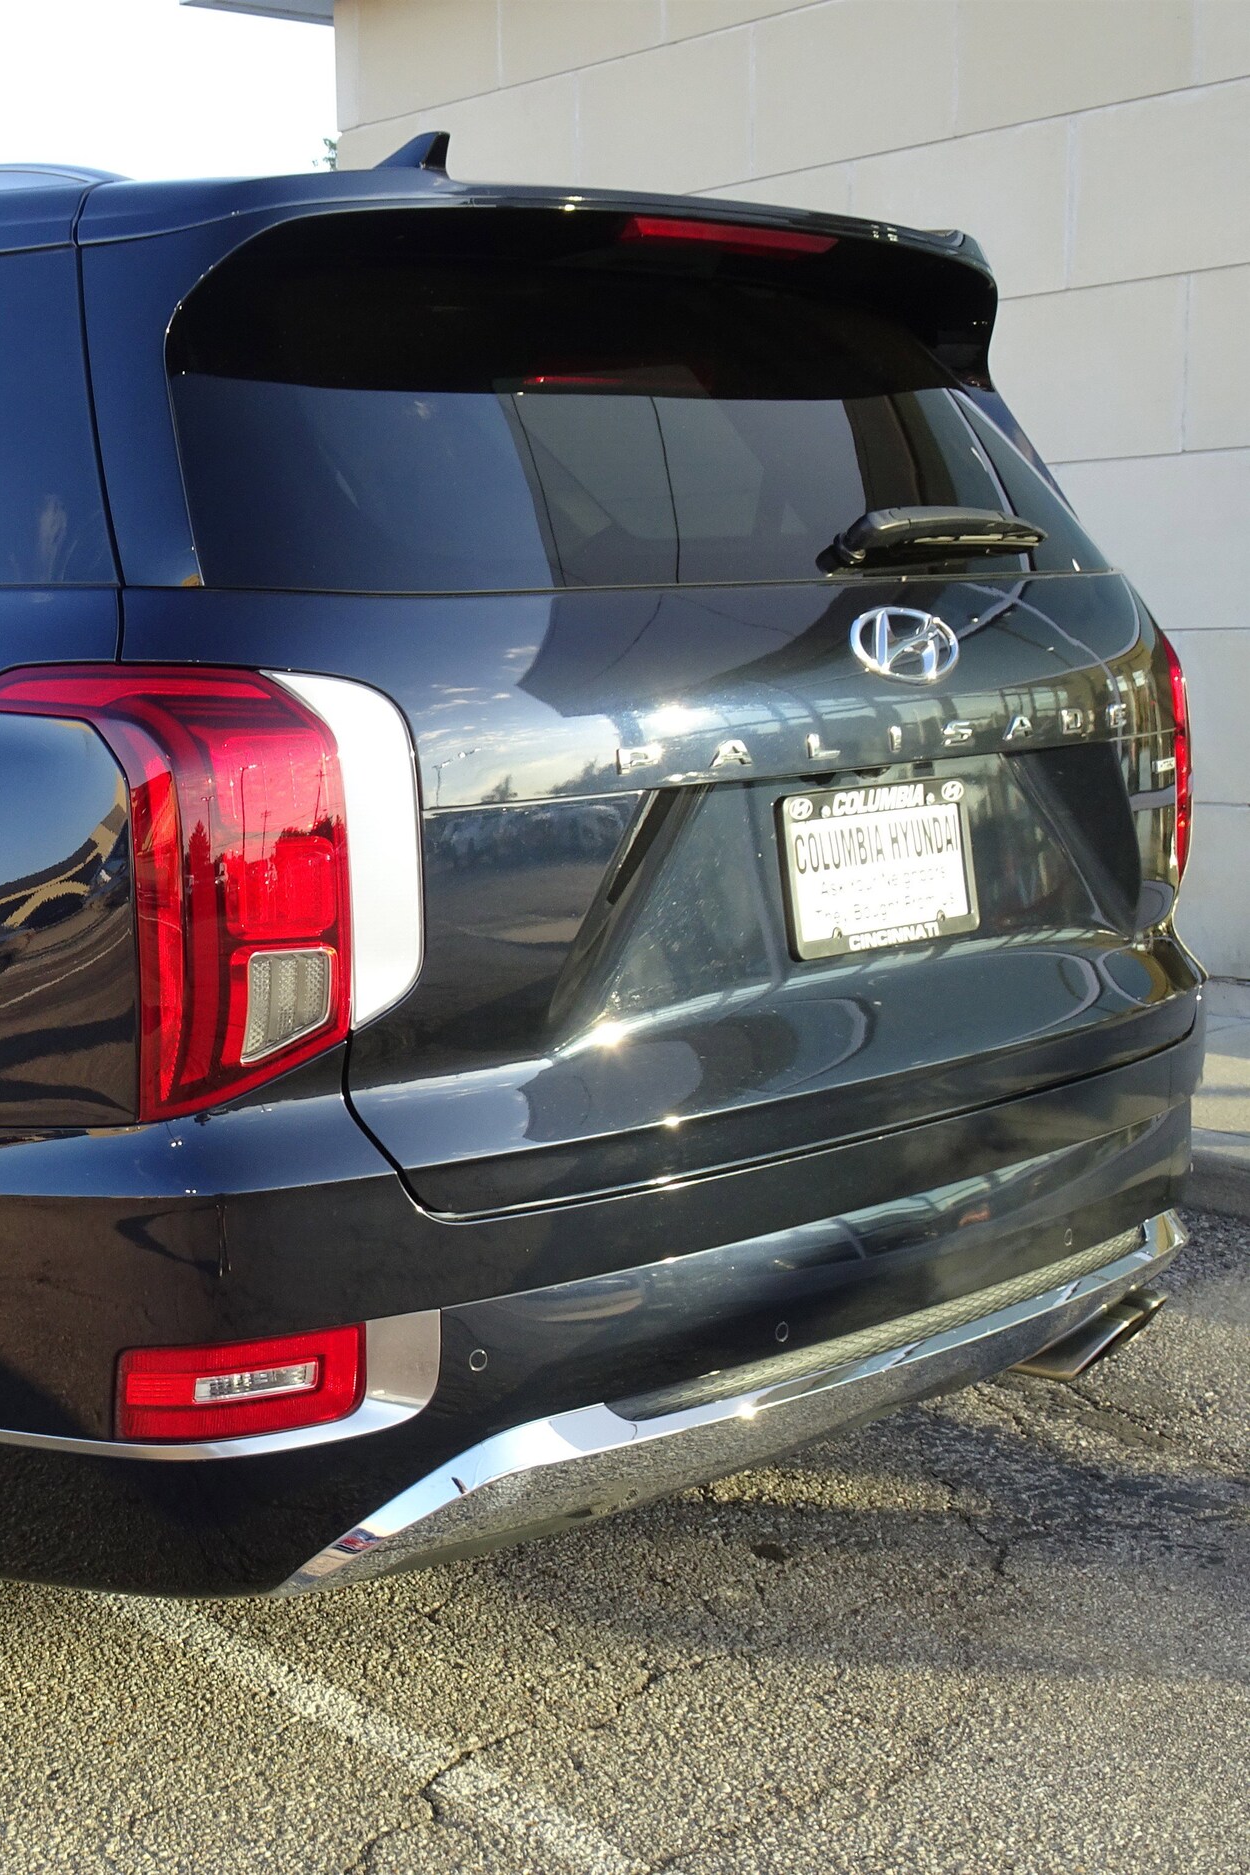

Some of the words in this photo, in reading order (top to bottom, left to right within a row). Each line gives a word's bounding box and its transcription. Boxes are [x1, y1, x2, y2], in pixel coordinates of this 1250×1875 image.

[616, 703, 1128, 776] PALISADE
[832, 784, 924, 816] COLUMBIA
[794, 824, 885, 874] COLUMBIA
[888, 814, 959, 860] HYUNDAI
[881, 866, 946, 889] Negos
[853, 900, 899, 921] Bogh
[848, 921, 940, 951] CINCINNATI
